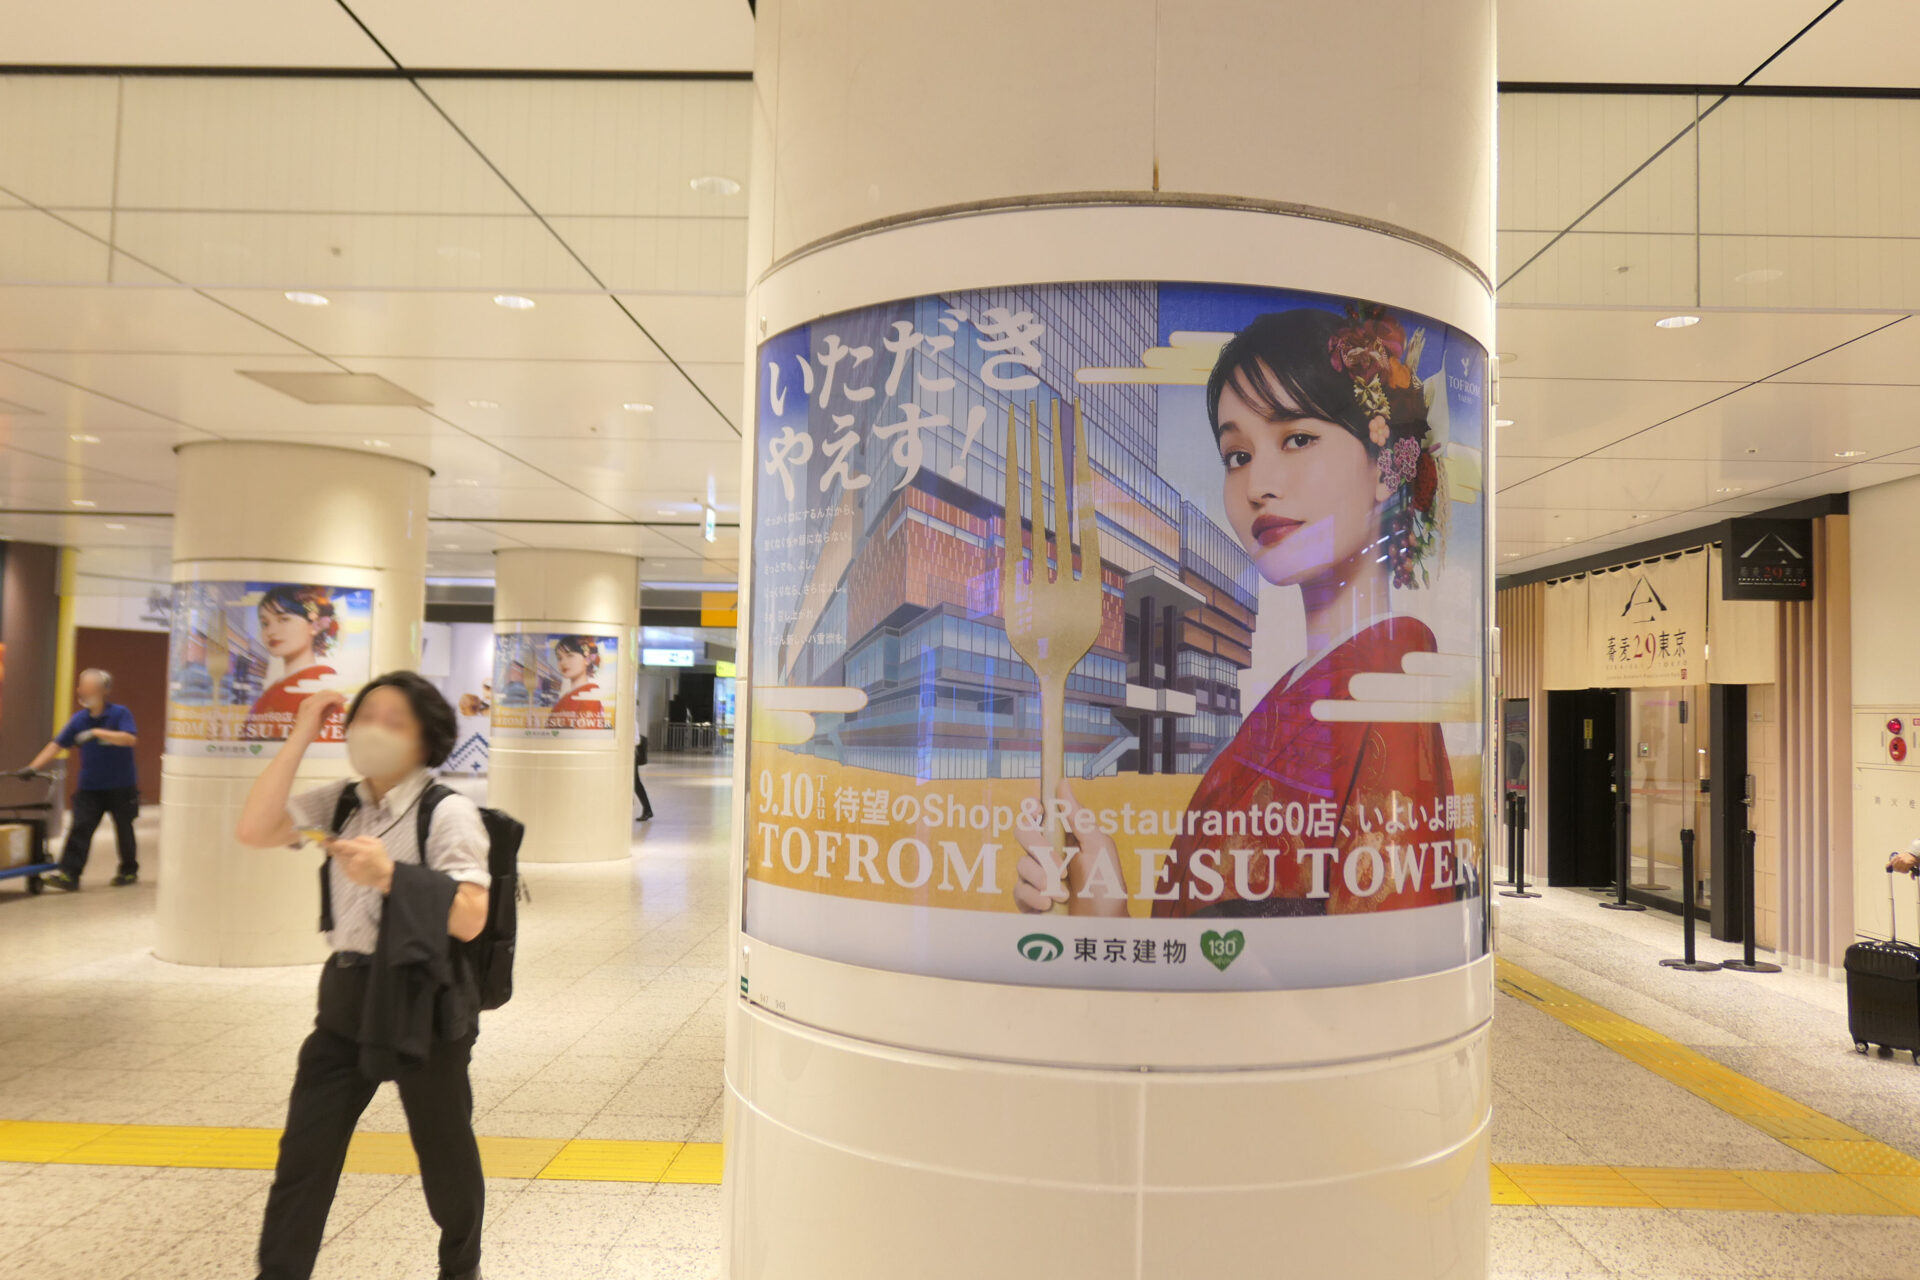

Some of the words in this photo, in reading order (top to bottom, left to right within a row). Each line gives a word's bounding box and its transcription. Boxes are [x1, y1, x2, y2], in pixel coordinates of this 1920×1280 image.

[769, 307, 1045, 416] いただき
[765, 403, 987, 501] やえす!
[760, 769, 814, 819] 9.10
[758, 822, 1002, 894] TOFROM
[1028, 845, 1281, 901] YAESU
[1297, 838, 1476, 899] TOWER
[1073, 937, 1187, 964] 東京建物
